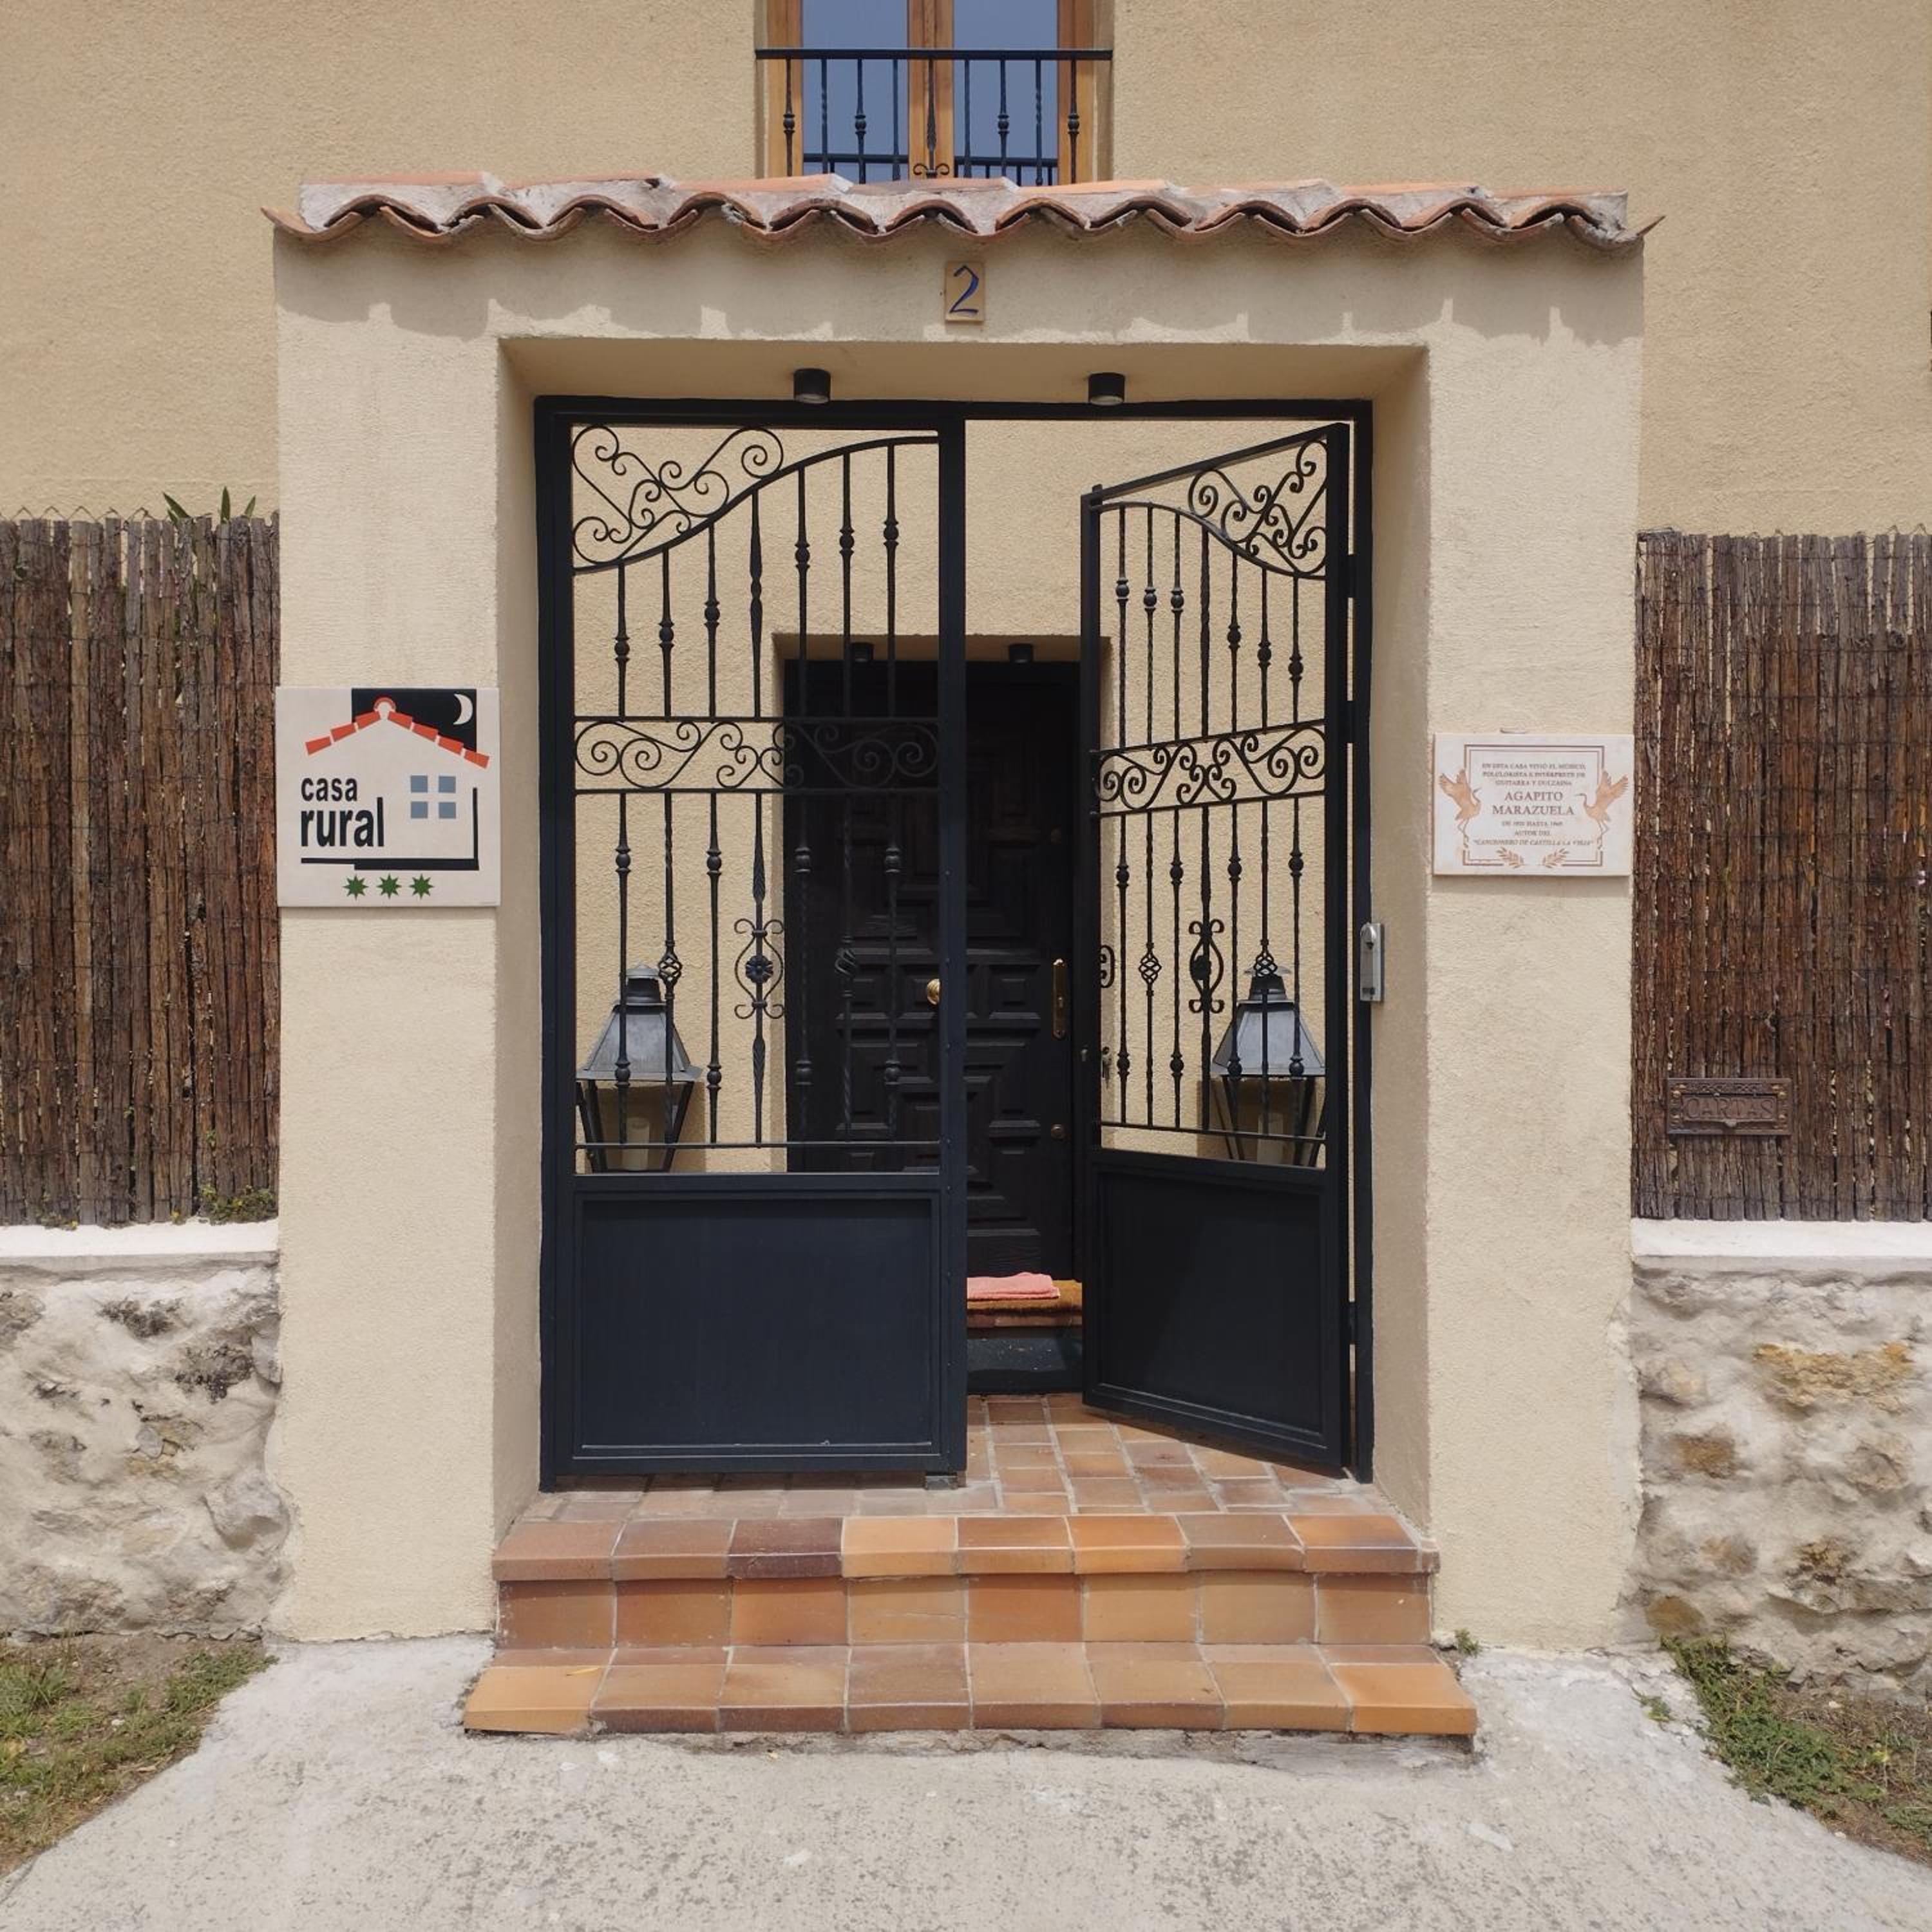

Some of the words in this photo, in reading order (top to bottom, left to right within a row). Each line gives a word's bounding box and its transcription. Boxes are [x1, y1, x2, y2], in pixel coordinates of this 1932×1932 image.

[949, 265, 979, 314] 2
[301, 777, 357, 802] casa
[1504, 791, 1564, 801] AGAPITO
[1492, 805, 1575, 815] MARAZUELA
[301, 797, 384, 848] rural
[1687, 1097, 1773, 1119] CARTAS
